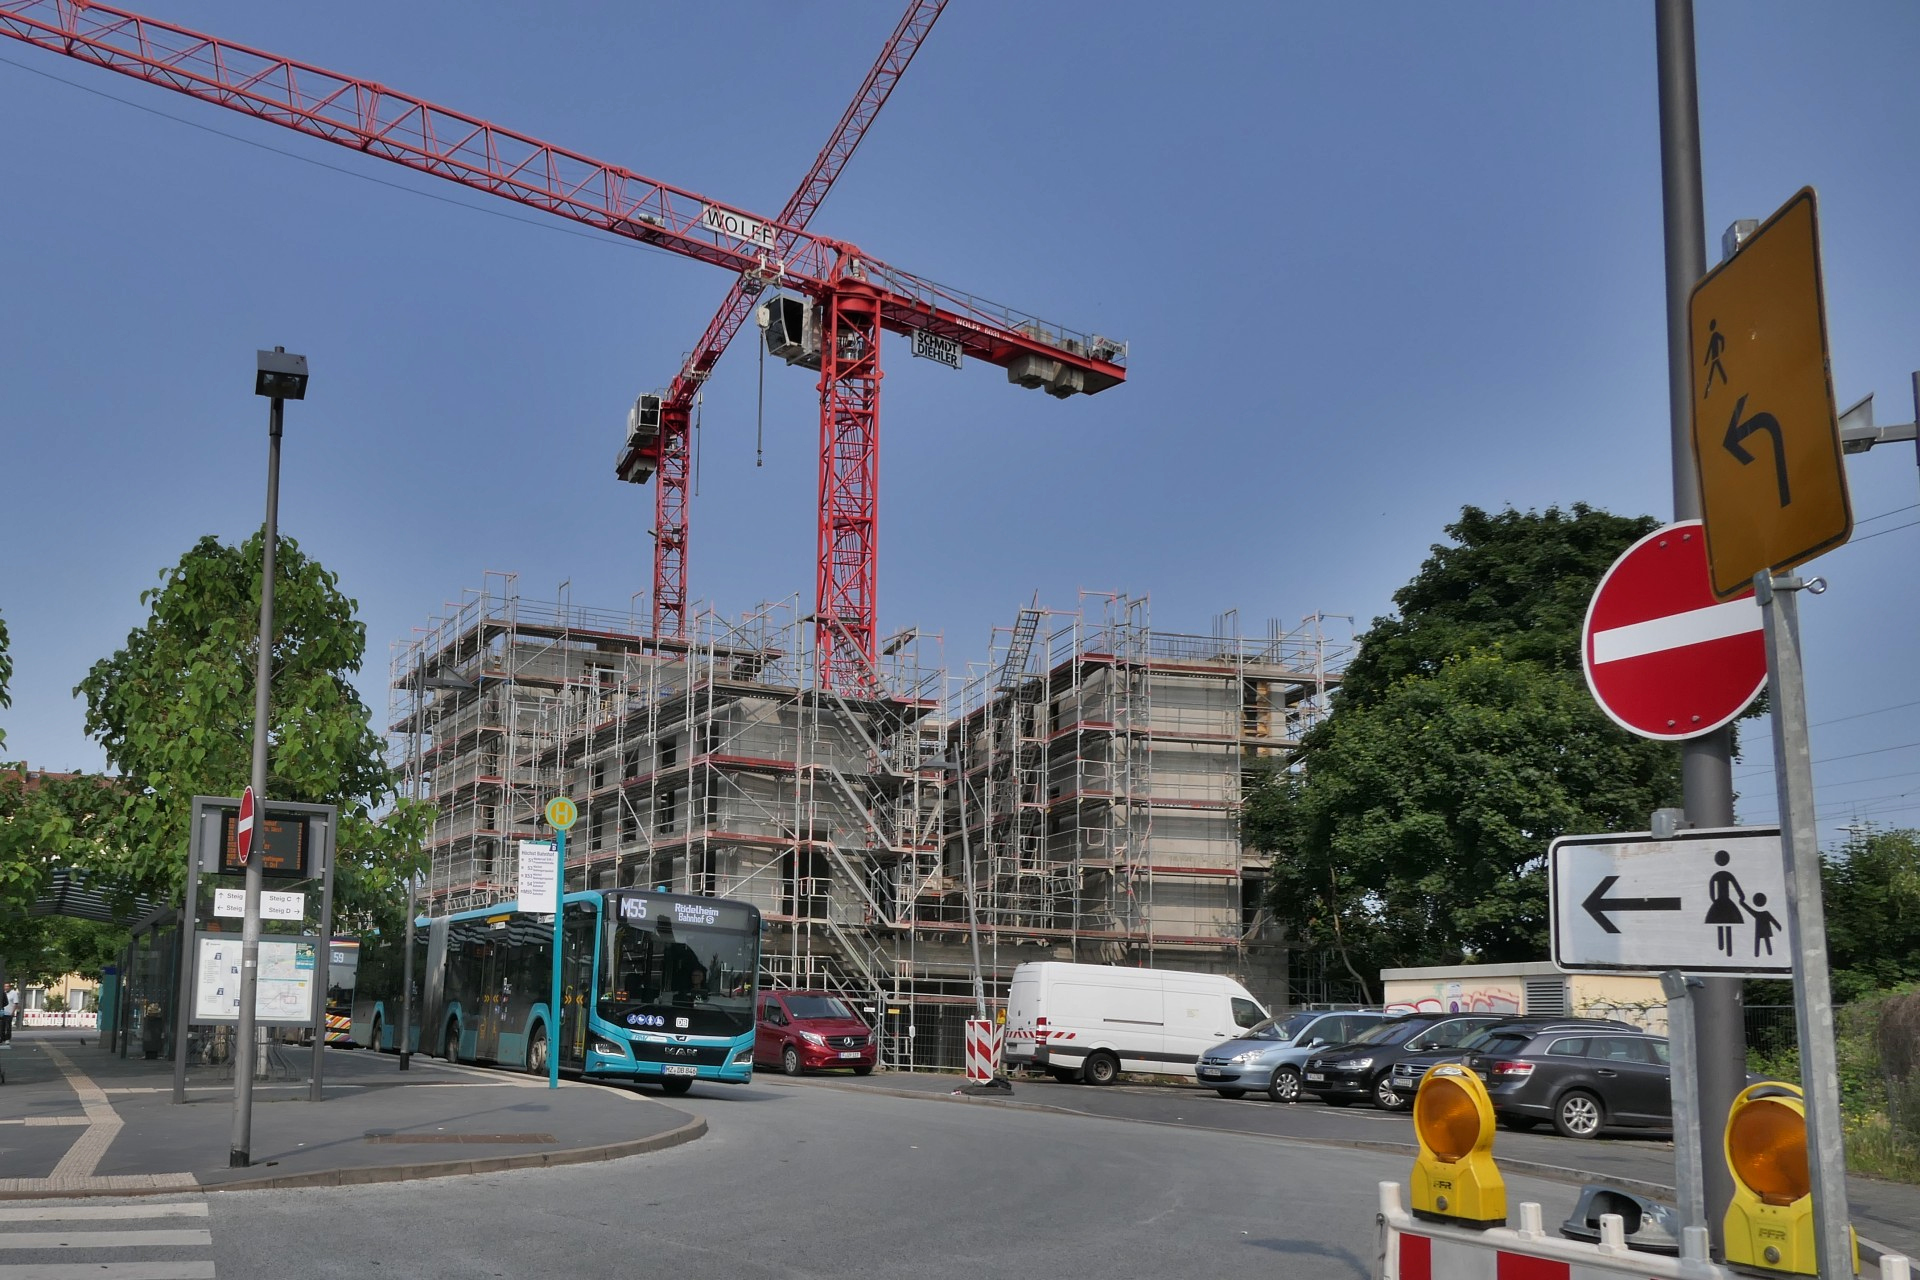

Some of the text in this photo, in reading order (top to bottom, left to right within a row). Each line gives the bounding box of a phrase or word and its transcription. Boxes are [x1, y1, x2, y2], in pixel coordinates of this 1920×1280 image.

[707, 209, 773, 243] WOLFF
[956, 317, 981, 331] WOLFF
[917, 343, 958, 366] DIEHLER
[555, 803, 568, 823] H
[620, 897, 648, 919] M55
[674, 902, 719, 917] Rödelheim
[678, 912, 705, 924] Bahnhof
[333, 952, 344, 963] 59
[676, 1017, 689, 1028] DB
[664, 1046, 698, 1057] MAN
